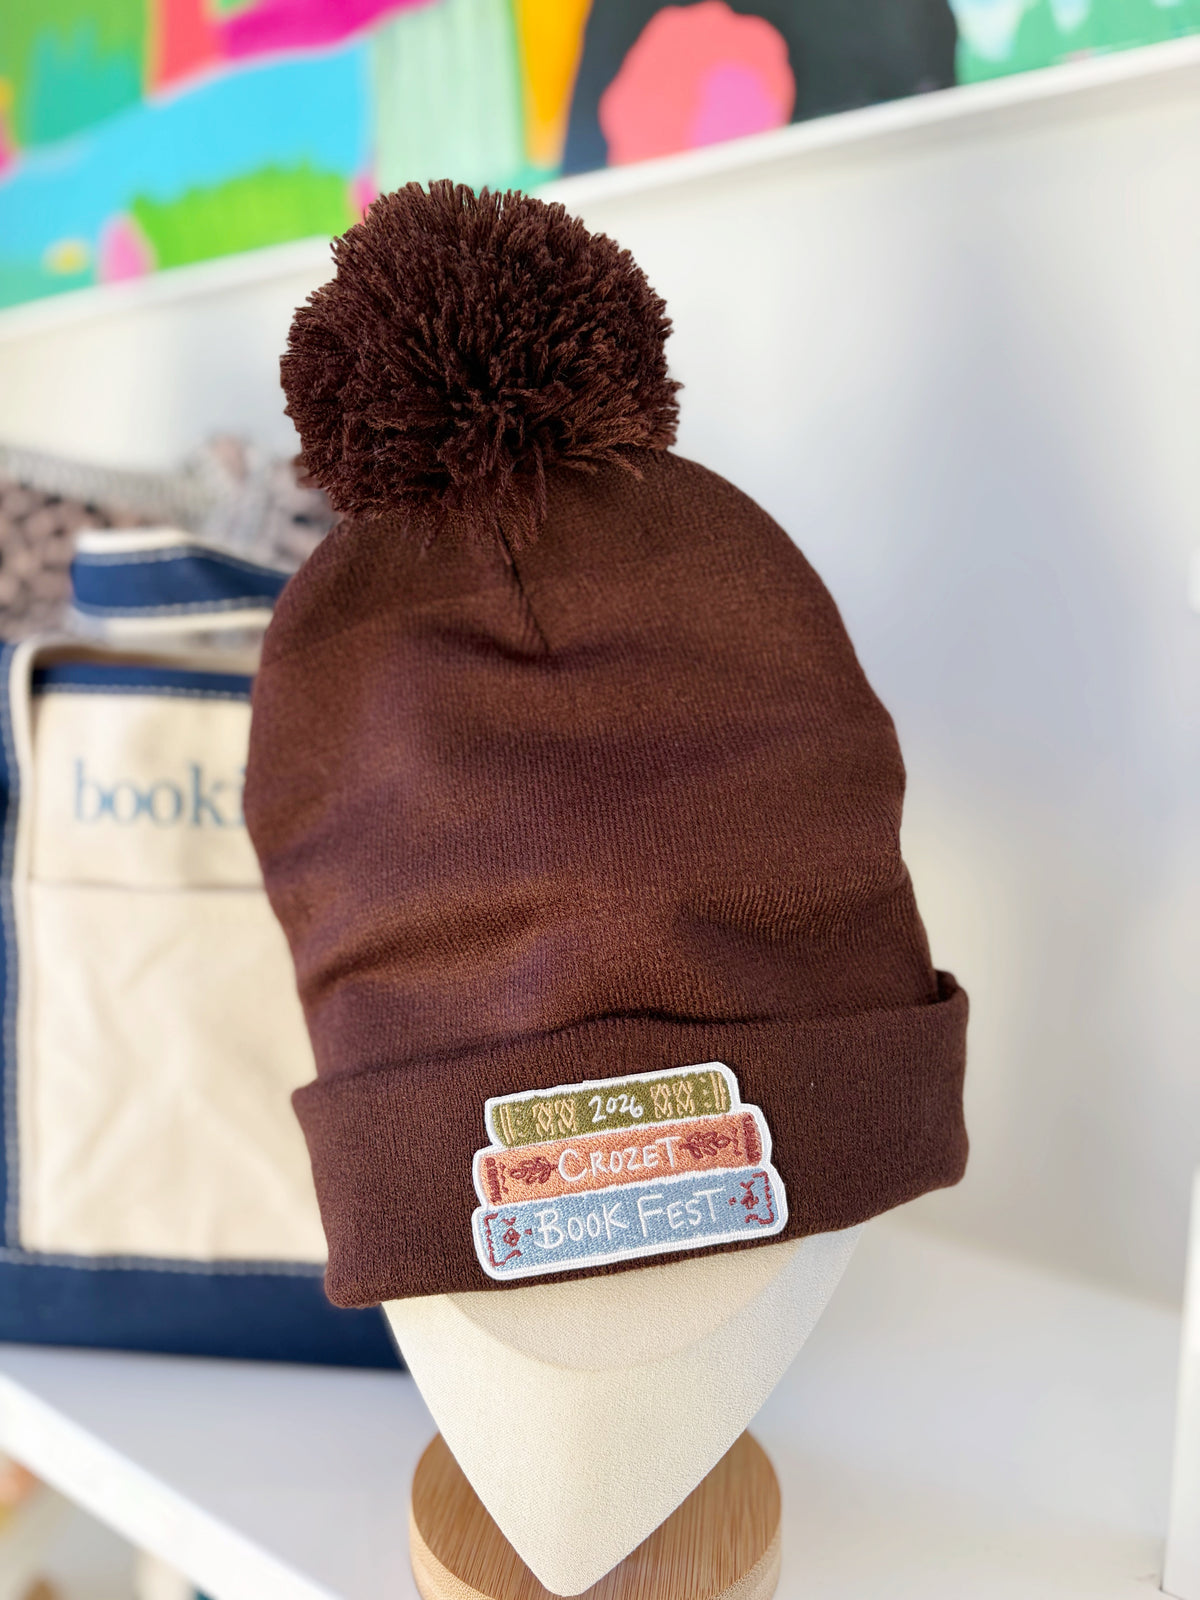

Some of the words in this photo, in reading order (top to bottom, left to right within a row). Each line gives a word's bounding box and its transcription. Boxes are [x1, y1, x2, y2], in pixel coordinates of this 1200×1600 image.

[588, 1094, 644, 1123] 2026
[557, 1135, 683, 1182] CROZET
[533, 1204, 628, 1249] BOOK
[637, 1187, 726, 1238] FEST
